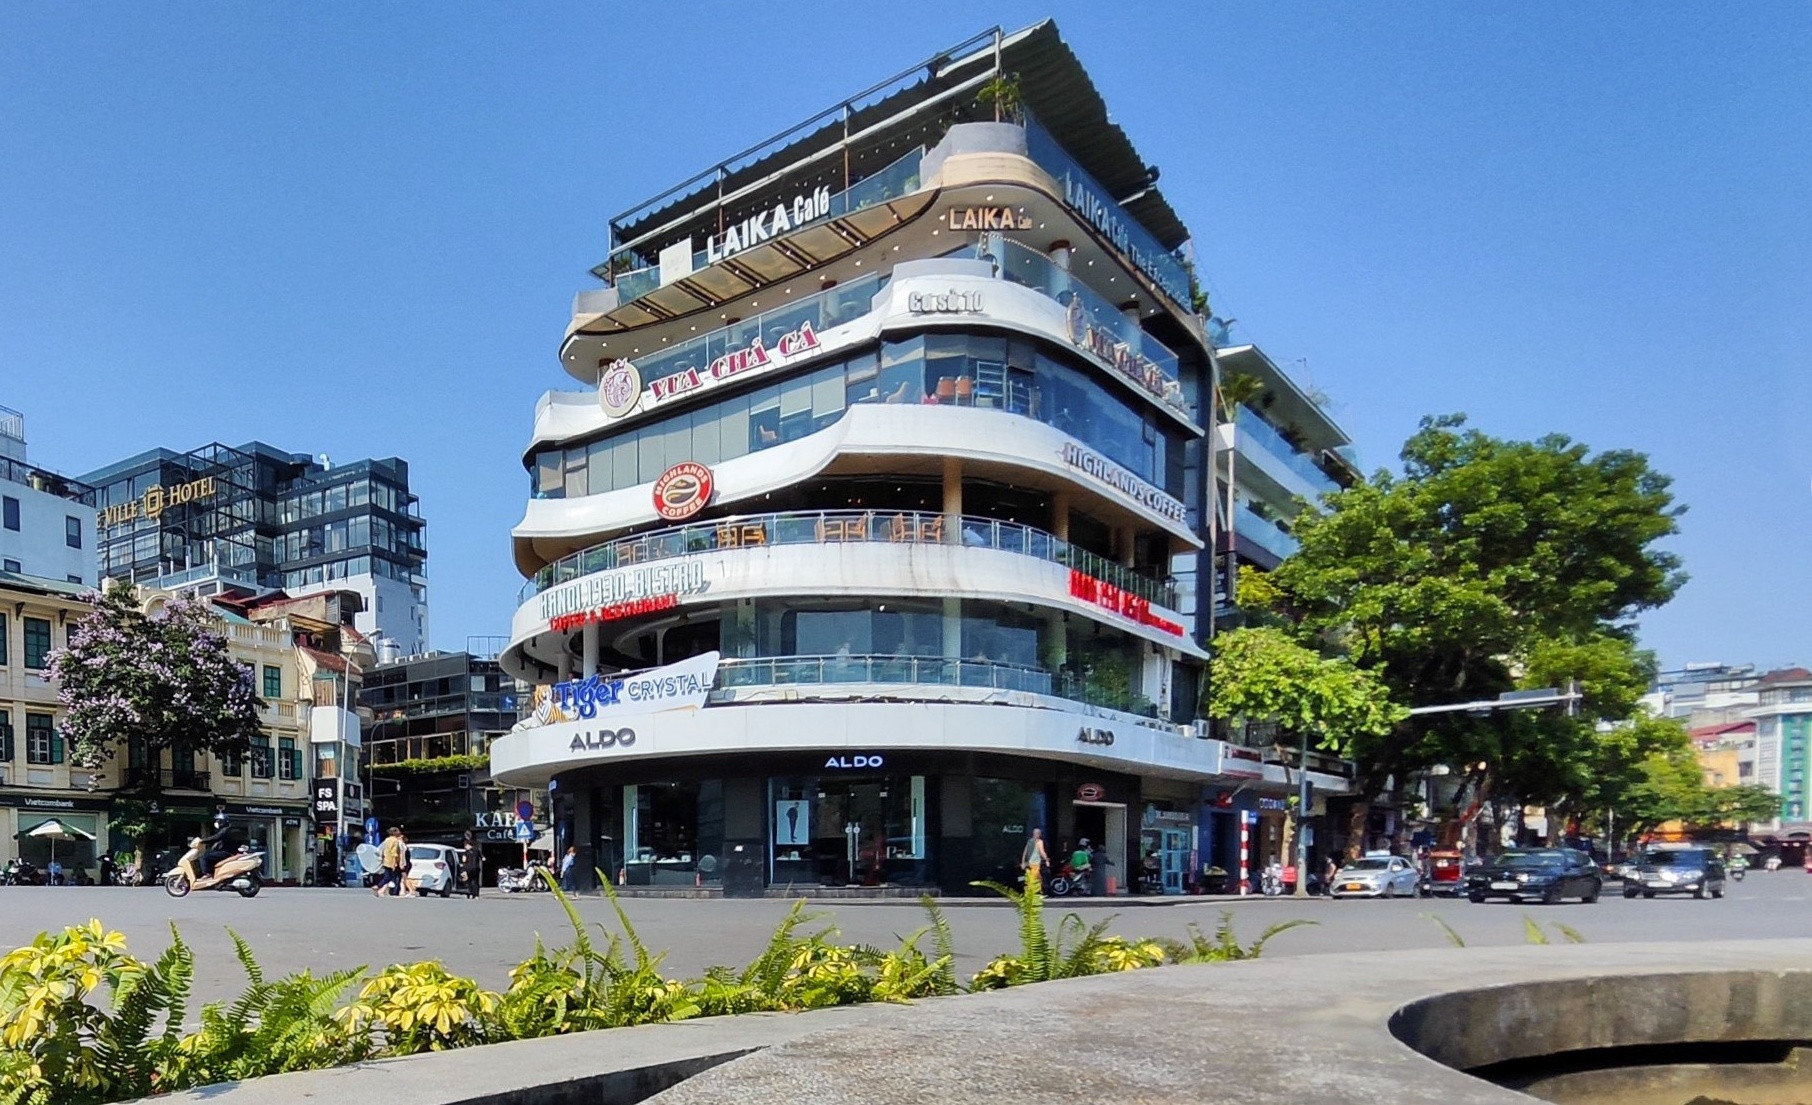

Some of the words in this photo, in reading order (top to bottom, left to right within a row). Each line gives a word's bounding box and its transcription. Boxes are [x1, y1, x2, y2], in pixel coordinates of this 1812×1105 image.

[1065, 168, 1111, 239] LAIKA
[707, 203, 791, 264] LAIKA
[793, 184, 831, 226] Café
[949, 207, 1015, 230] LAIKA
[962, 290, 985, 312] 10
[649, 366, 703, 401] VUA
[709, 336, 772, 381] CHẢ
[777, 319, 822, 358] CÁ
[655, 465, 709, 496] HIGHLANDS
[1061, 442, 1145, 500] HIGHLANDS
[1144, 488, 1188, 521] COFFEE
[104, 500, 138, 525] VILLE
[169, 476, 217, 507] HOTEL
[661, 497, 703, 517] COFFEE
[540, 582, 581, 619] HANOI
[587, 573, 628, 608] 1930
[634, 560, 704, 597] BISTRO
[555, 674, 624, 719] Tiger
[628, 672, 713, 701] CRYSTAL
[569, 727, 636, 753] ALDO
[1077, 726, 1115, 746] ALDO
[824, 755, 883, 768] ALDO
[24, 798, 74, 808] Vietcombank
[318, 787, 333, 798] FS
[245, 806, 283, 815] Vietcombank
[316, 801, 336, 812] SPA
[1002, 825, 1025, 834] ALDO
